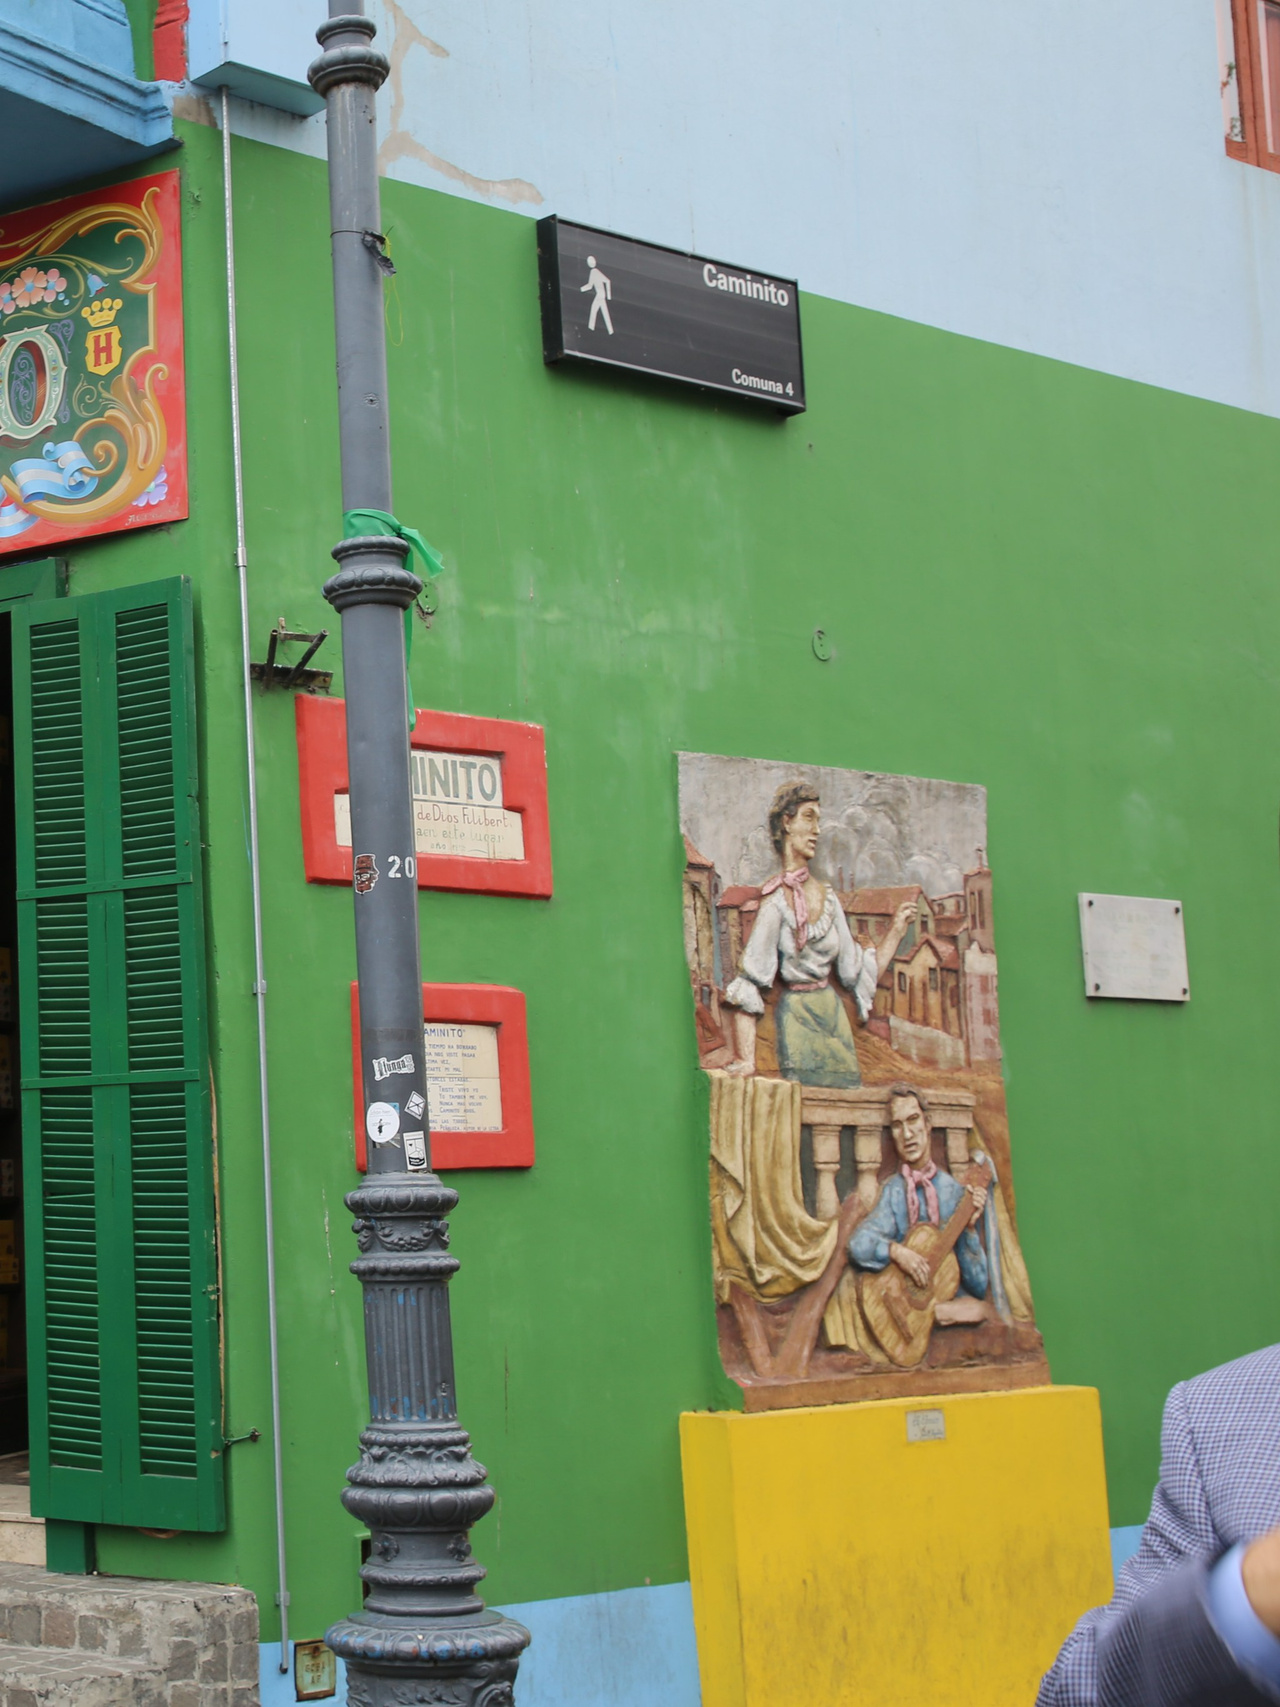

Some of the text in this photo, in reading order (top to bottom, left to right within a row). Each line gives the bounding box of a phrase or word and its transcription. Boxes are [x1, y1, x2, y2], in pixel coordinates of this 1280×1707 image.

[703, 263, 789, 307] Caminito
[732, 369, 794, 397] Comuna 4
[411, 755, 497, 802] INITO
